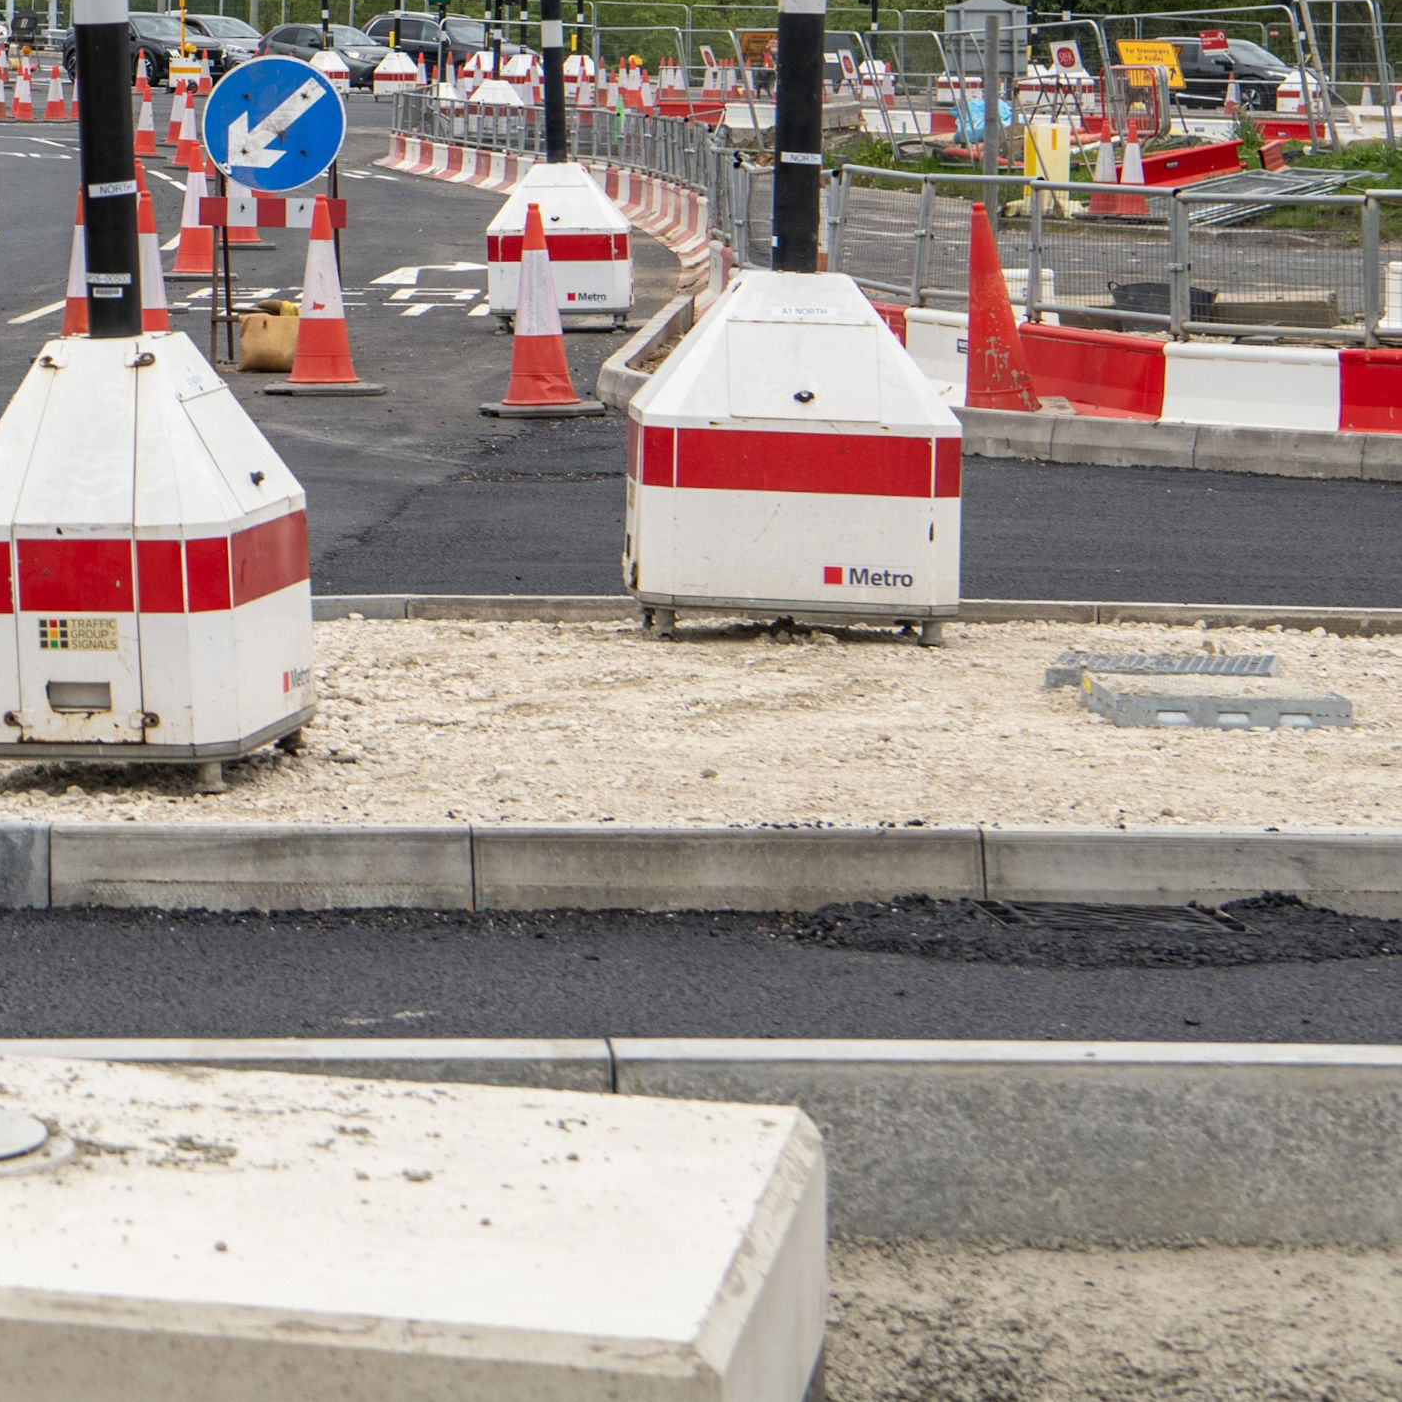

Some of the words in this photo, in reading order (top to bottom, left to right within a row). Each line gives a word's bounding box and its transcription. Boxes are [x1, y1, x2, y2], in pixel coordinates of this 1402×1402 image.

[99, 183, 133, 195] NORTH
[578, 292, 607, 301] Metro
[795, 307, 828, 315] NORTH
[849, 568, 913, 587] Metro
[70, 619, 117, 629] TRAFFIC
[70, 629, 109, 639] GROUP
[71, 639, 117, 649] SIGNALS
